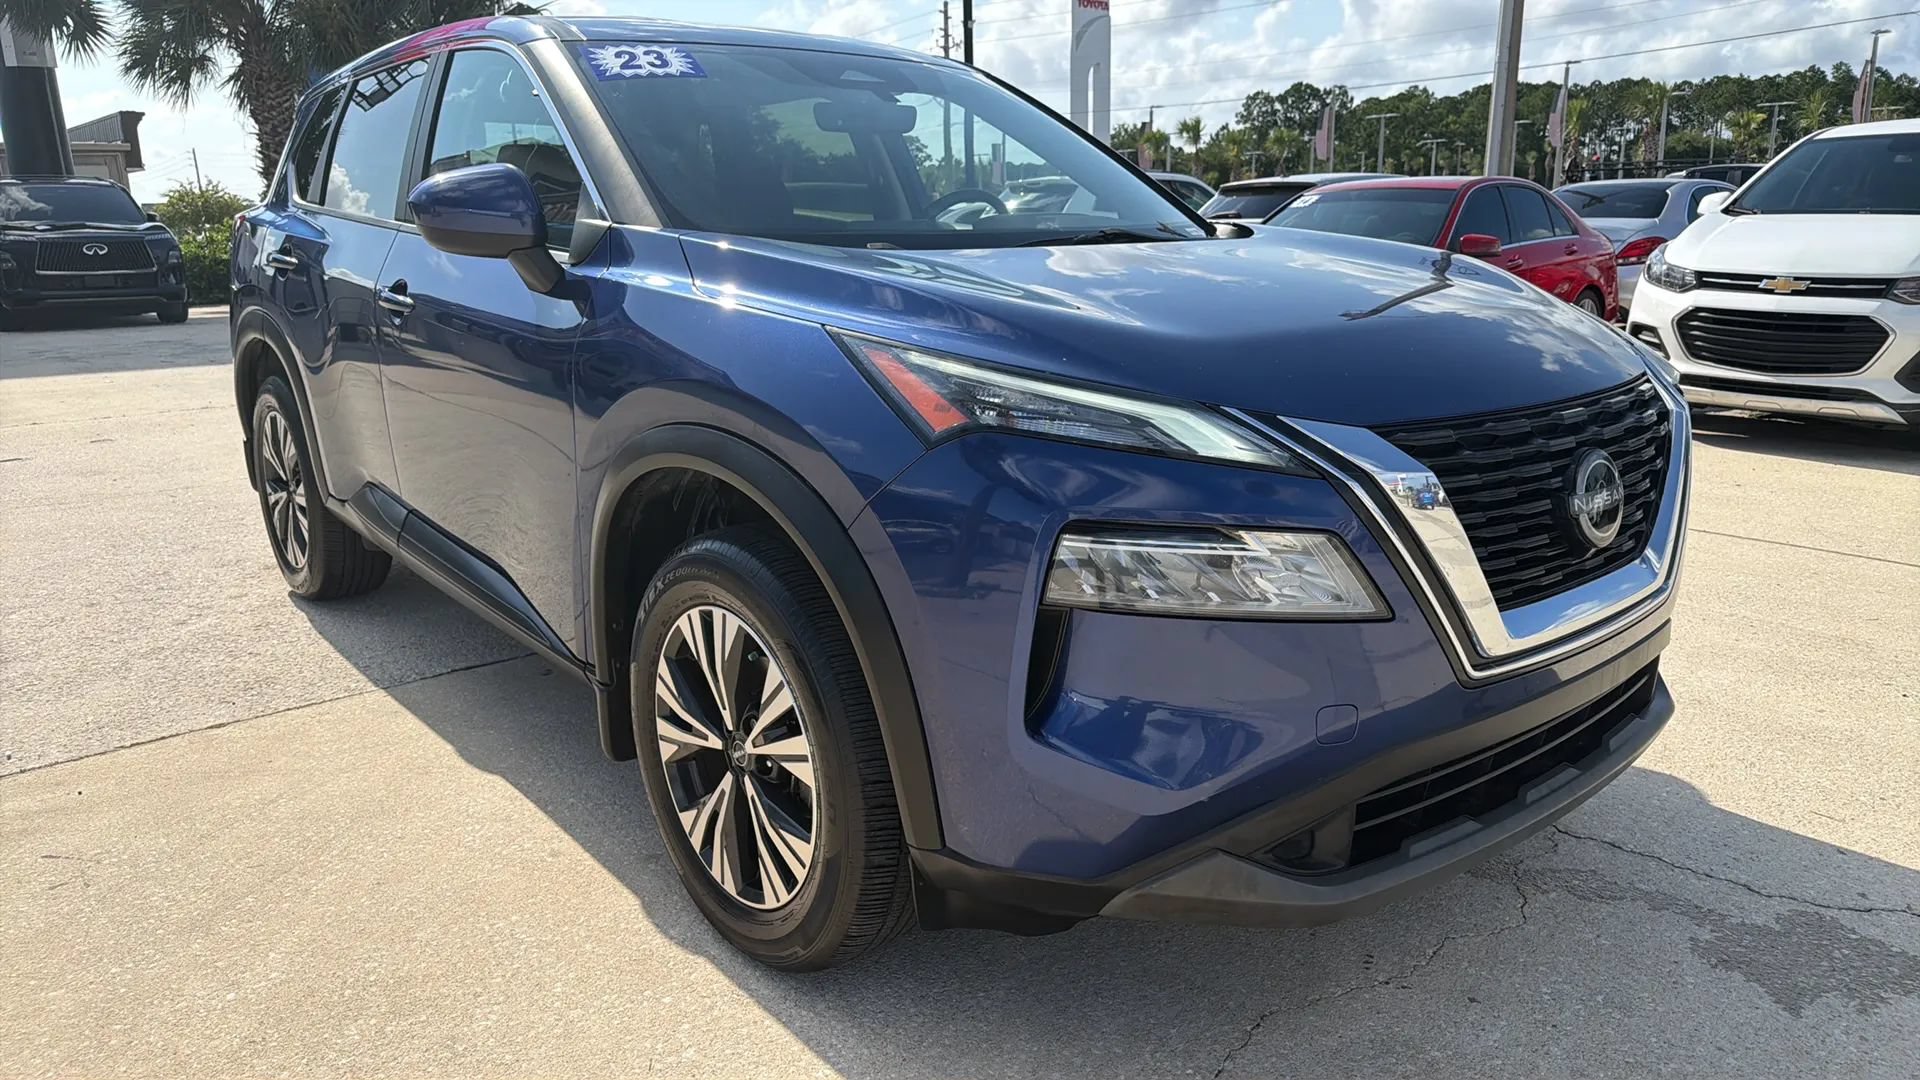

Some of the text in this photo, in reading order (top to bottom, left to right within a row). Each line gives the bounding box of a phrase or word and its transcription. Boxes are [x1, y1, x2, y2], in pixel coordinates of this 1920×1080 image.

[1077, 0, 1109, 11] TOYOTA
[614, 49, 671, 70] 23
[1574, 488, 1625, 512] NISSAN
